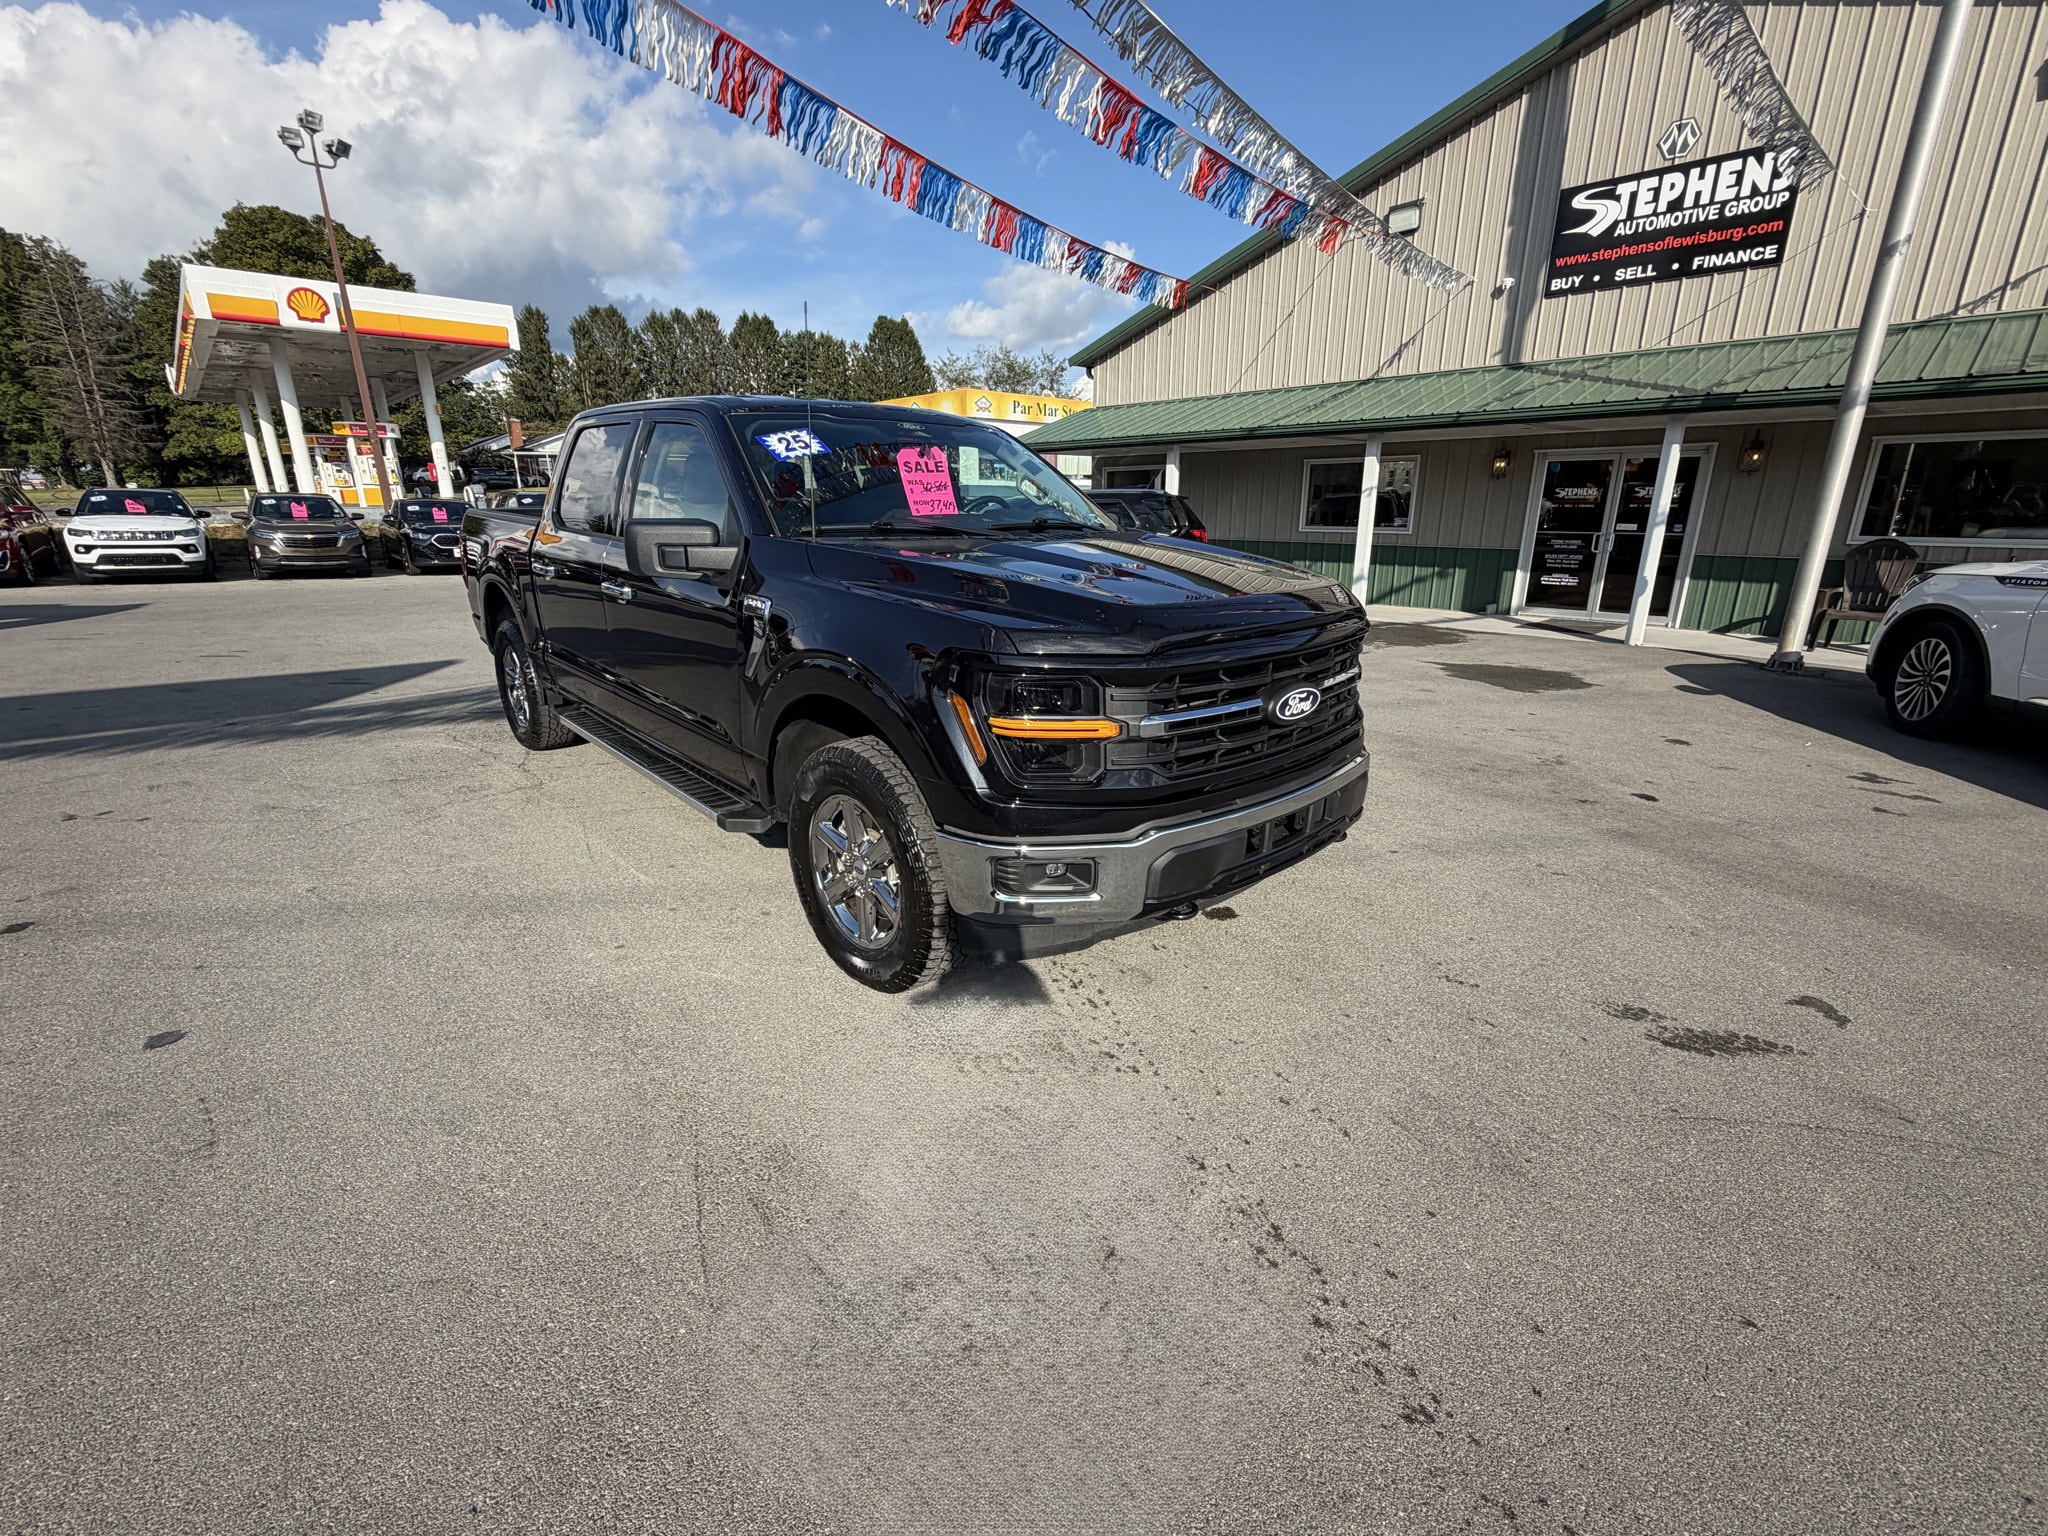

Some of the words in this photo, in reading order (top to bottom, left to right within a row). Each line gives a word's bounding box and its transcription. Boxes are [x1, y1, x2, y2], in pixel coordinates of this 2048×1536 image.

[1560, 146, 1798, 237] STEPHENS
[1613, 204, 1721, 237] AUTOMOTIVE
[1724, 191, 1790, 217] GROUP
[1555, 220, 1784, 267] www.stephensoflewisburg.com
[1550, 275, 1584, 291] BUY
[1614, 264, 1657, 281] SELL
[1692, 244, 1779, 270] FINANCE
[1012, 400, 1033, 415] Par
[1036, 402, 1060, 417] Mar
[777, 434, 811, 452] 25
[1553, 487, 1598, 498] STEPHENS
[1285, 692, 1313, 716] Ford
